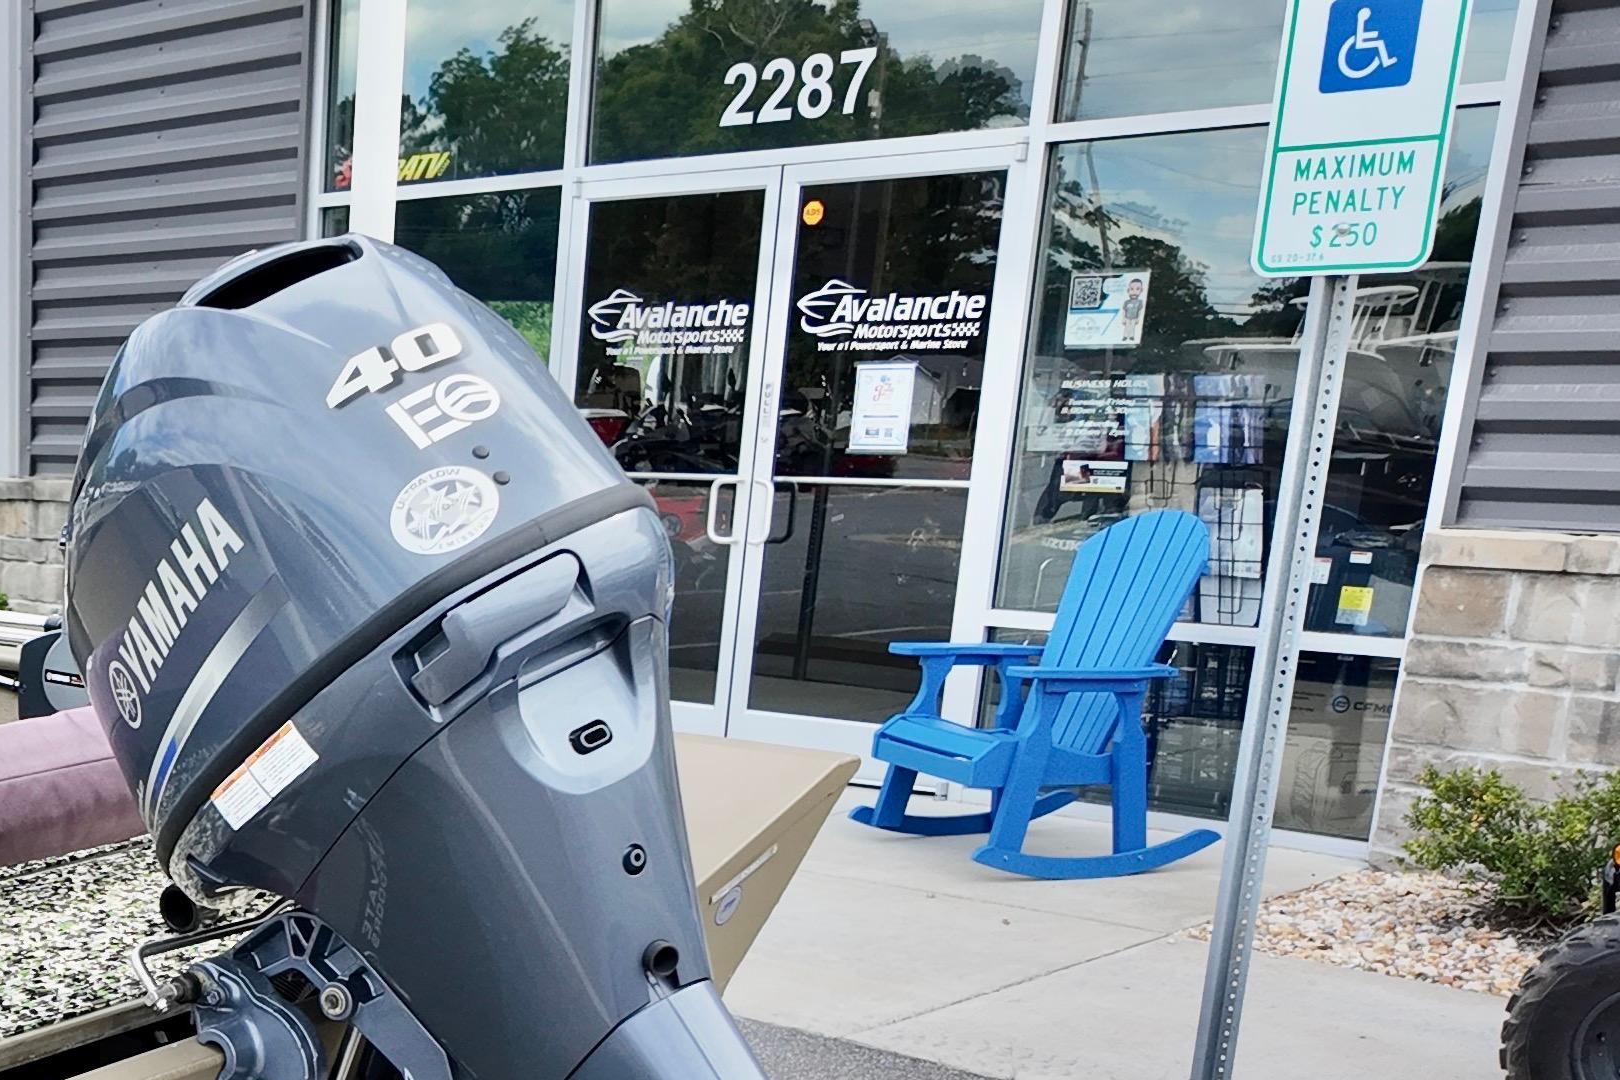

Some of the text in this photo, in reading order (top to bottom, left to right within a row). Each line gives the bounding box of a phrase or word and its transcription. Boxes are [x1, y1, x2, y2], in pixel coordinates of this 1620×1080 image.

[719, 47, 877, 127] 2287
[1294, 150, 1416, 182] MAXIMUM
[1292, 186, 1406, 216] PENALTY
[616, 299, 750, 329] Avalanche
[830, 290, 987, 323] Avalanche
[636, 329, 720, 346] Motorsports
[853, 322, 953, 339] Motorsports
[942, 339, 968, 349] Store
[325, 322, 462, 410] 40
[1061, 379, 1112, 389] BUSINESS
[428, 468, 461, 480] LOW
[118, 497, 245, 695] YAMAHA
